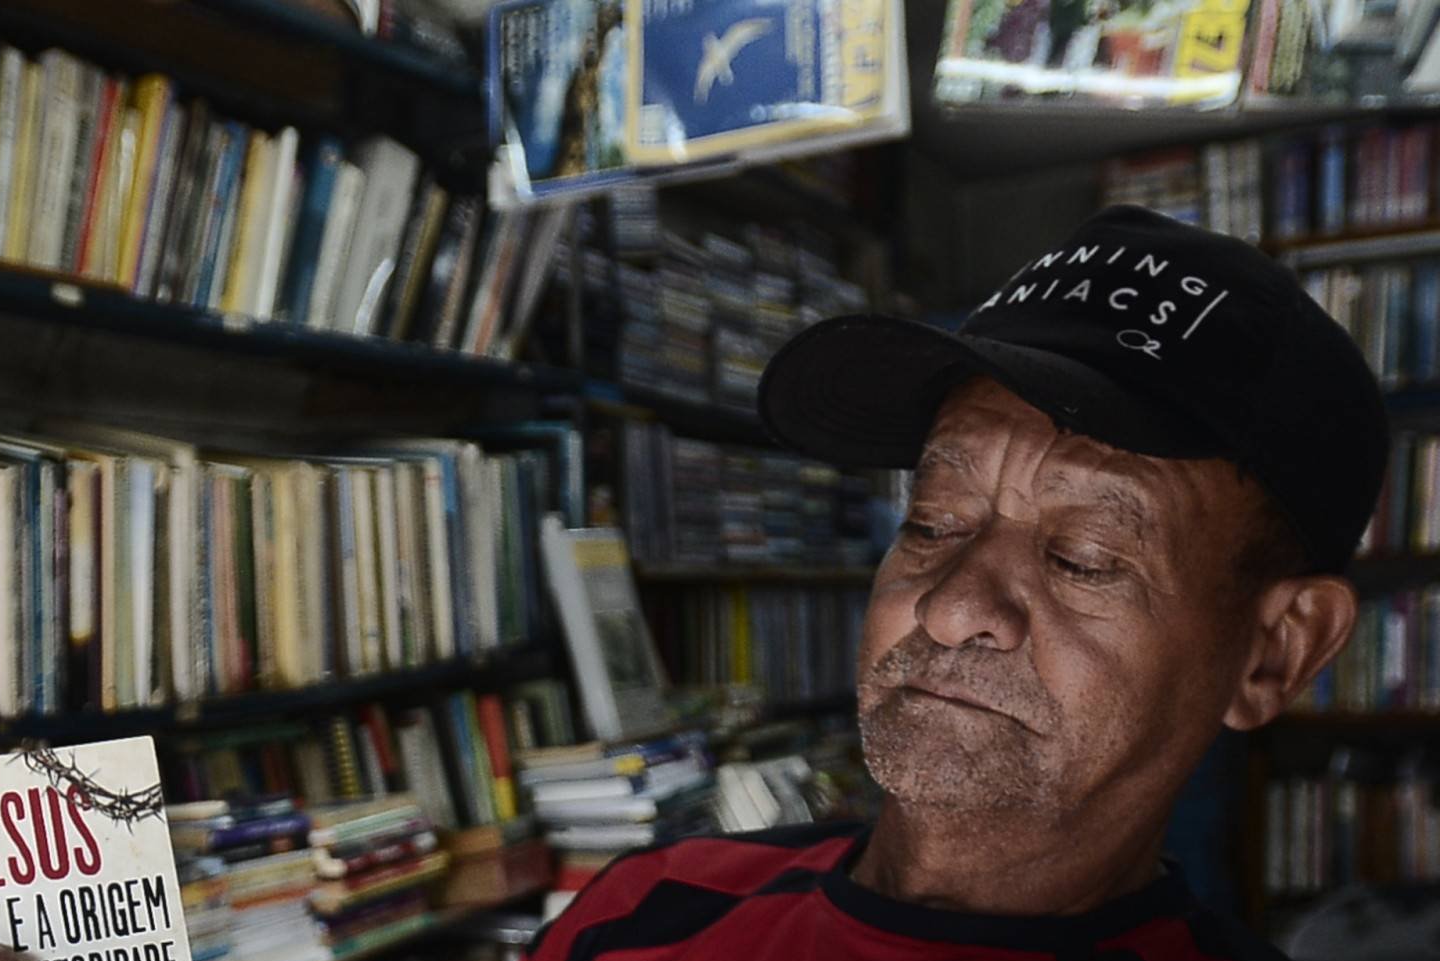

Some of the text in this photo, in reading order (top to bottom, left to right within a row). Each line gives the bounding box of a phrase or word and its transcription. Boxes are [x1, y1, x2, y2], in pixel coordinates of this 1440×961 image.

[1010, 245, 1208, 296] NNING
[976, 279, 1176, 325] ANIACS
[6, 897, 29, 951] E
[35, 894, 57, 950] A
[60, 876, 171, 945] ORIGEM
